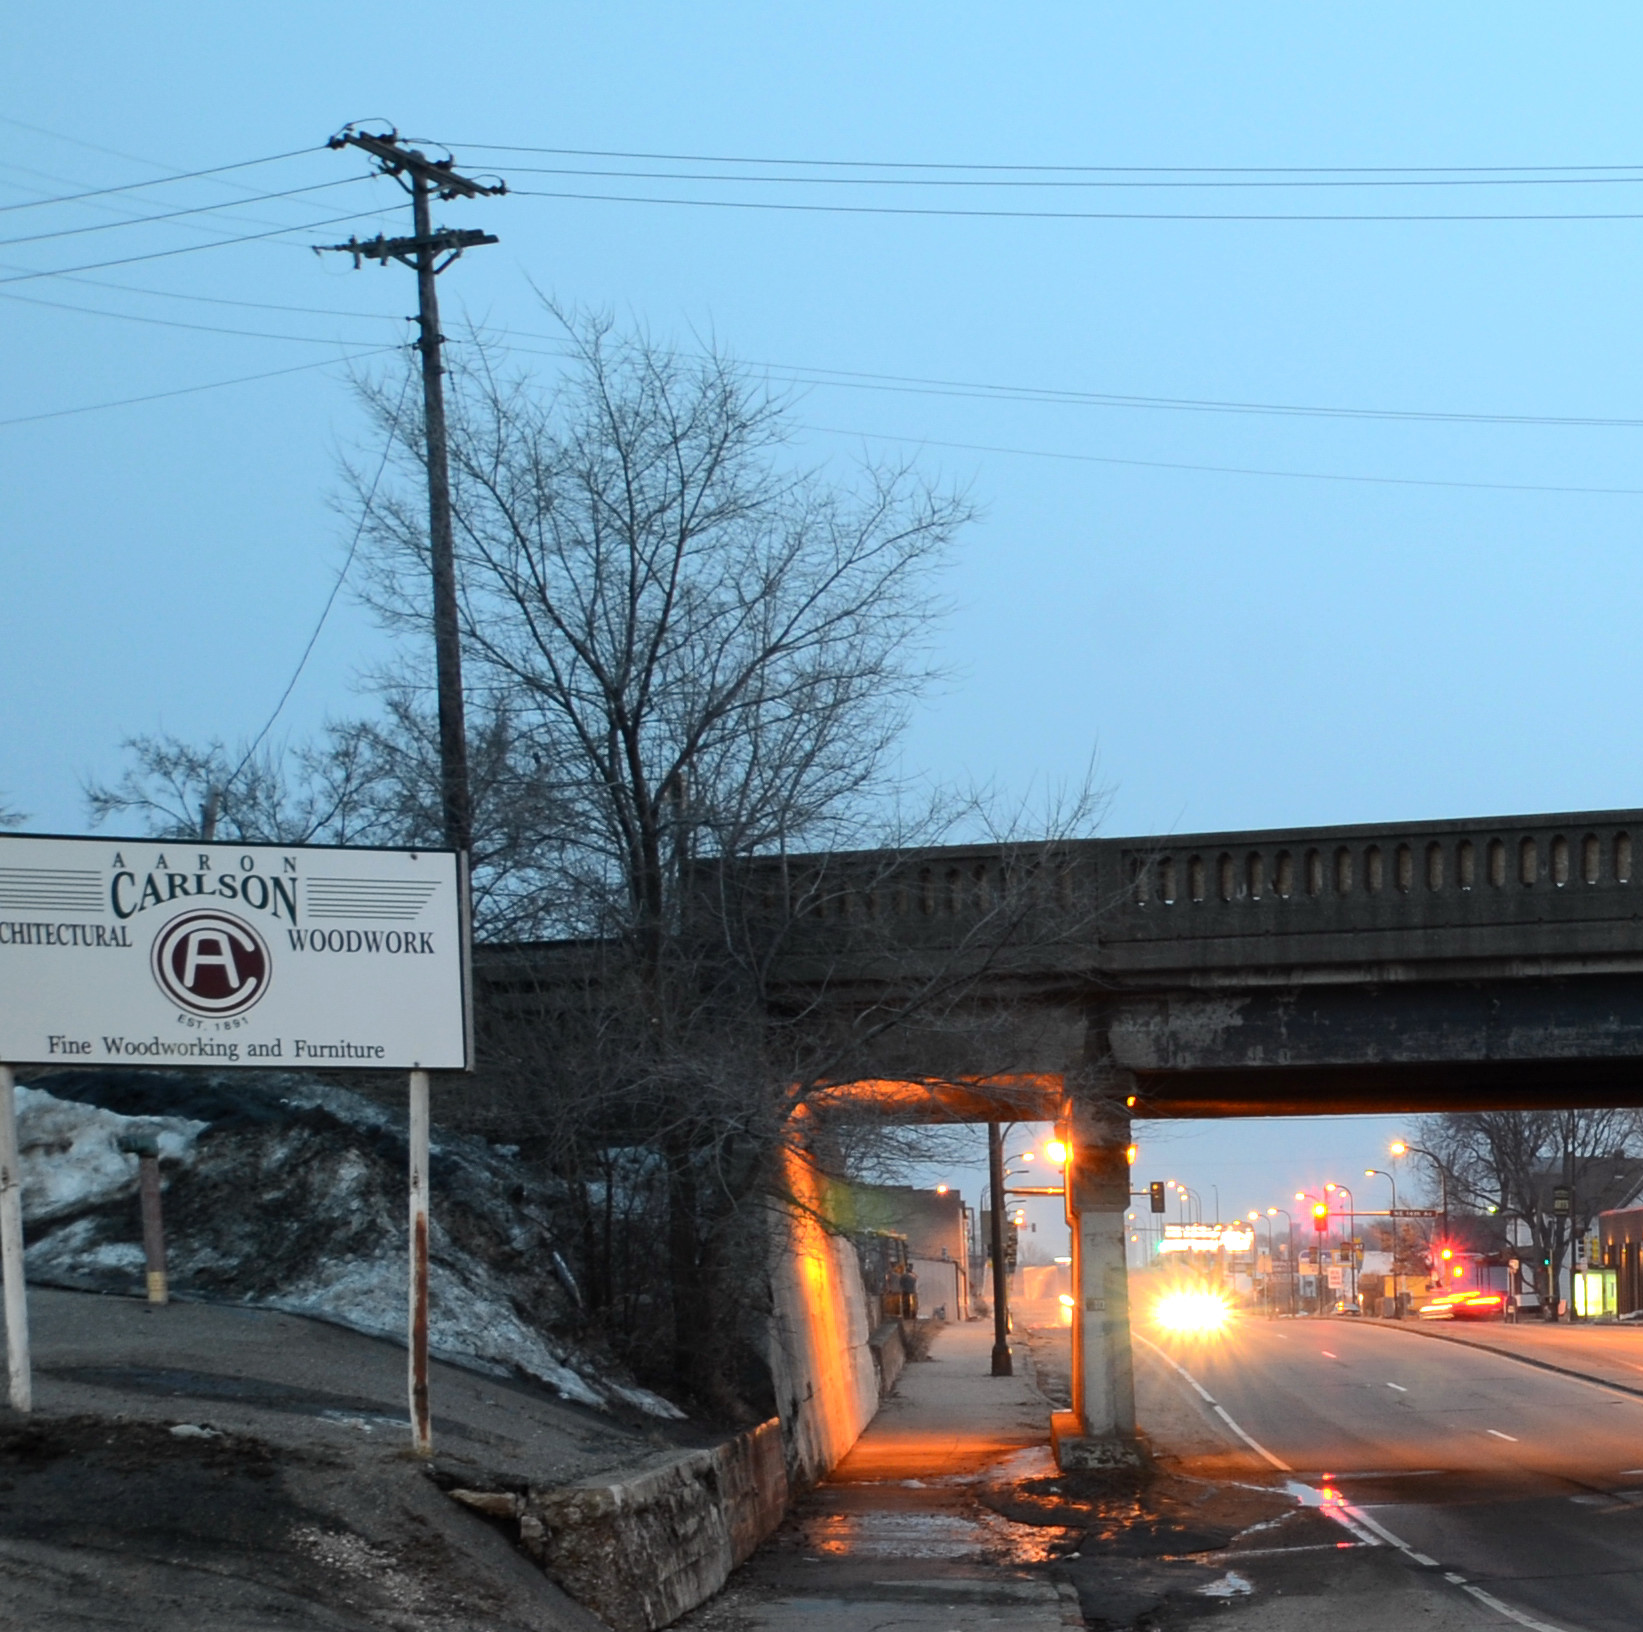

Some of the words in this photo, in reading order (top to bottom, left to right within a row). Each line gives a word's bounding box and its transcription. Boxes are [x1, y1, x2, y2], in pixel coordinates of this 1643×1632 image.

[112, 852, 298, 873] AARON
[111, 871, 298, 927] CARLSON
[287, 928, 434, 954] WOODWORK
[47, 1035, 92, 1055] Fine
[102, 1036, 240, 1062] Woodworking
[247, 1038, 282, 1057] and
[294, 1039, 386, 1059] Furniture
